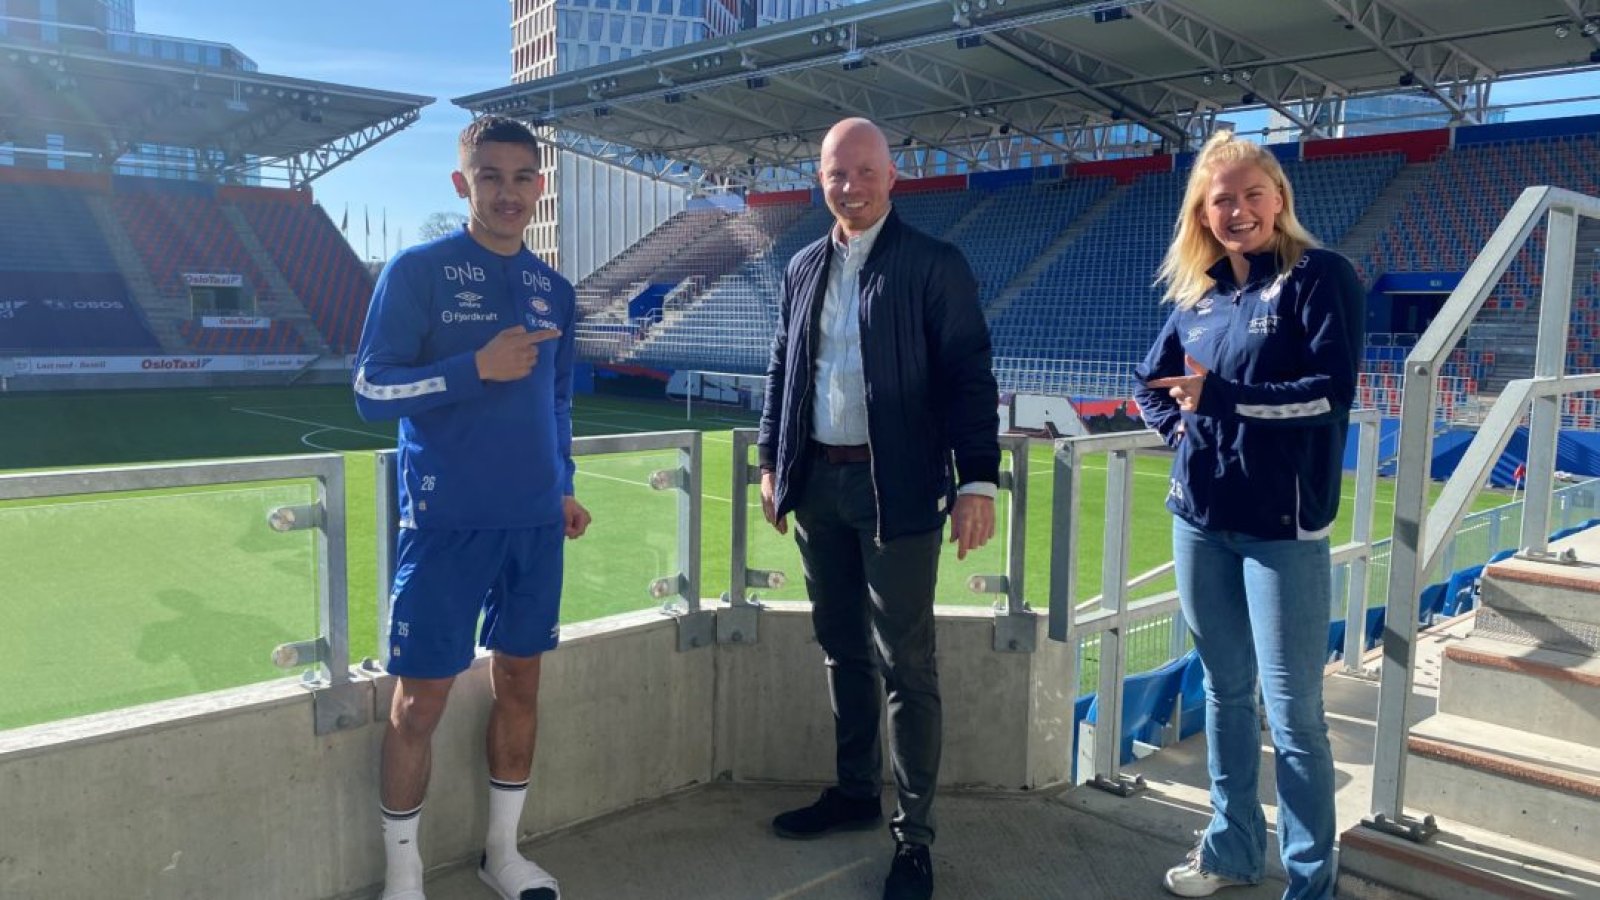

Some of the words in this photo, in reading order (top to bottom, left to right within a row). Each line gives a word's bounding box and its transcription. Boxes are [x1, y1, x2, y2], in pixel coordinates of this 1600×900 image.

[443, 261, 486, 286] DNB
[522, 269, 552, 293] DNB
[142, 358, 200, 369] OsloTaxi
[421, 475, 436, 491] 26
